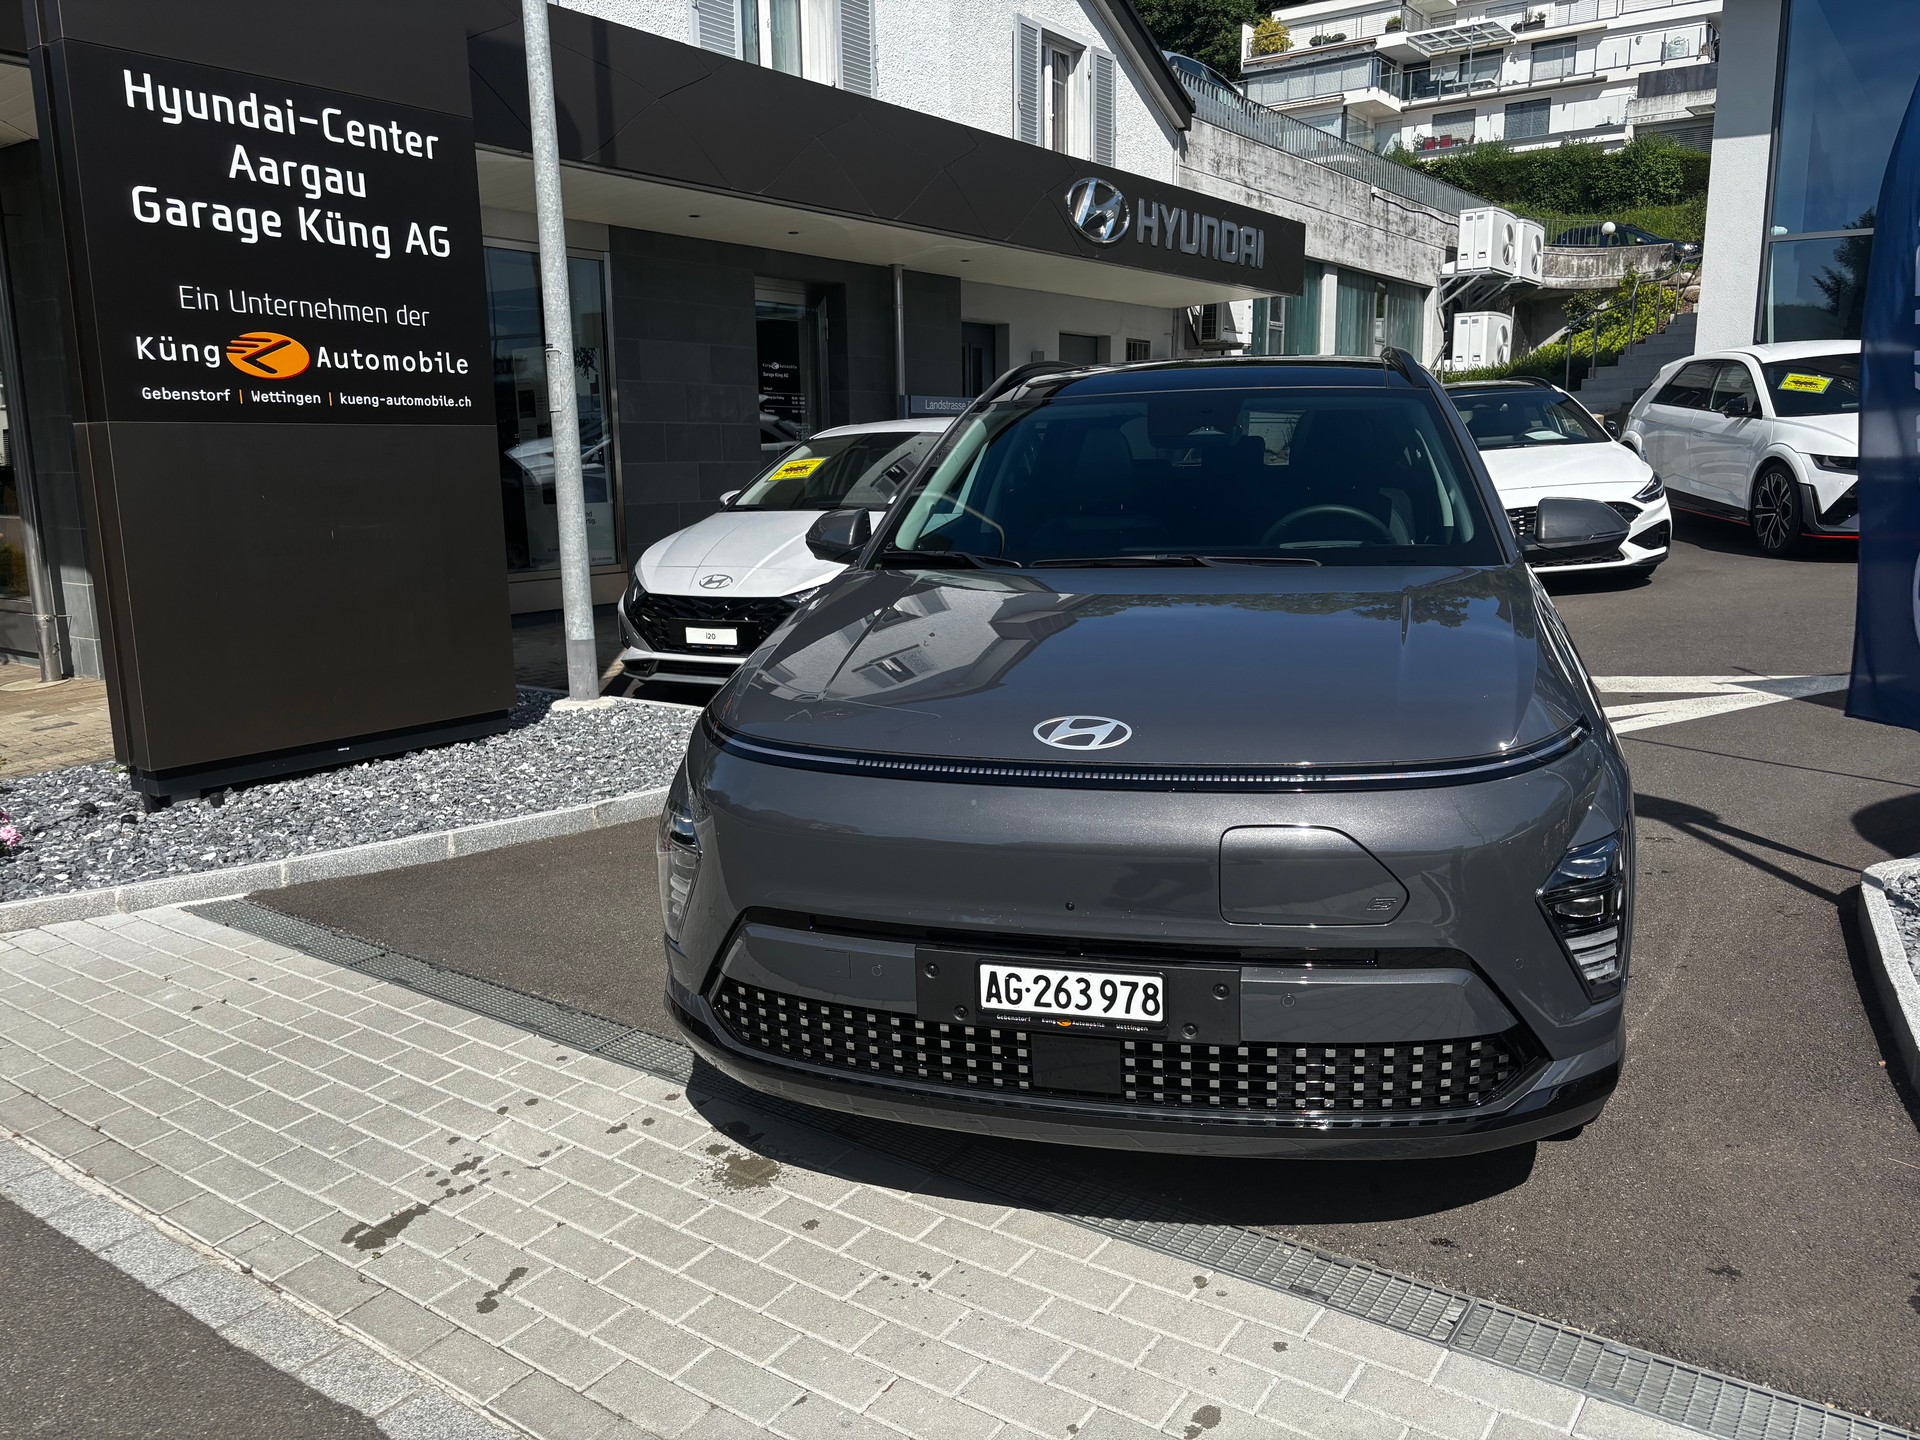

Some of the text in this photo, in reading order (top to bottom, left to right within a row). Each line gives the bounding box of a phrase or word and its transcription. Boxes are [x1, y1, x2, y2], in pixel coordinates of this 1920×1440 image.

[123, 69, 439, 160] Hyundai-Center
[228, 144, 367, 199] Aargau
[131, 185, 451, 259] Garage Küng AG
[1136, 197, 1265, 269] HYUNDAI
[179, 285, 430, 327] Ein Unternehmen der
[135, 336, 469, 374] Küng Automobile
[141, 386, 472, 408] Gebenstorf Wettingen kueng-automobile.ch
[925, 399, 967, 411] Landstrasse
